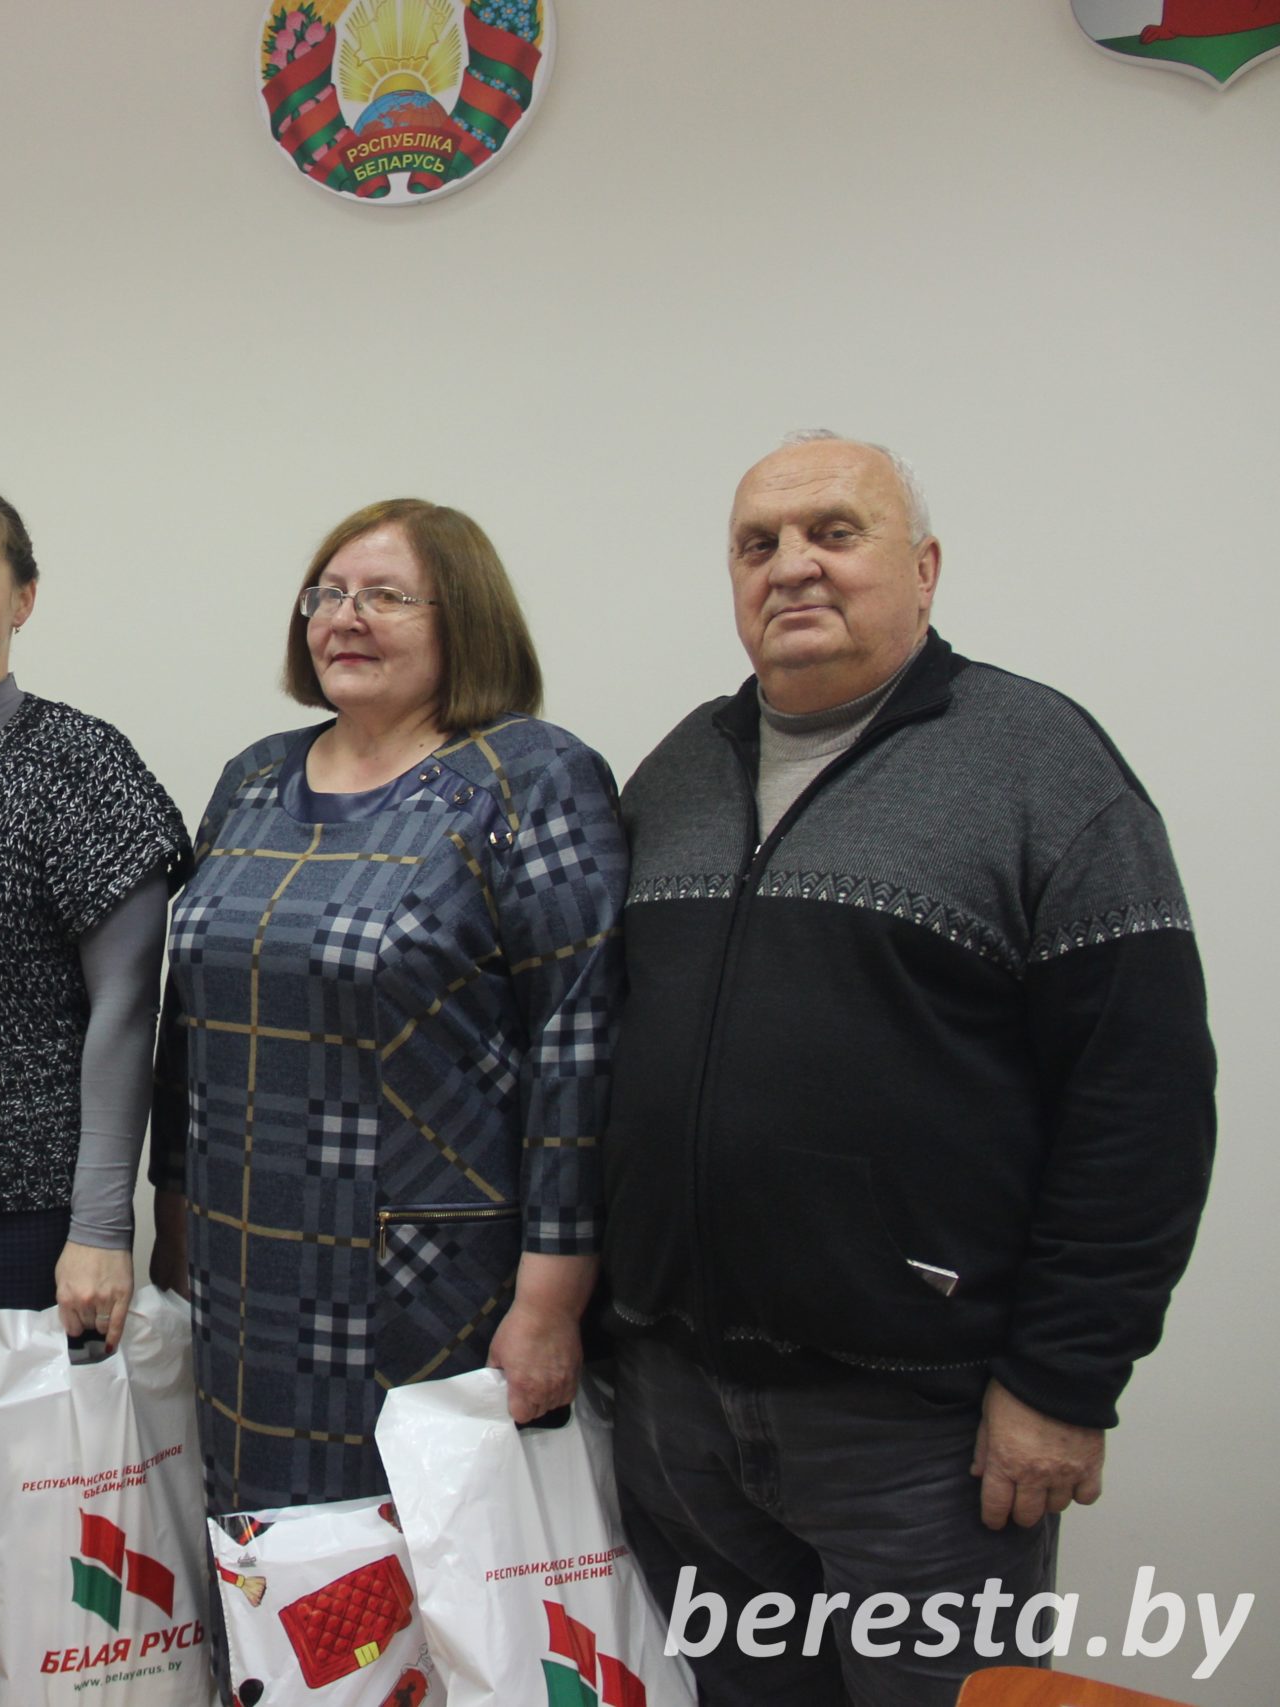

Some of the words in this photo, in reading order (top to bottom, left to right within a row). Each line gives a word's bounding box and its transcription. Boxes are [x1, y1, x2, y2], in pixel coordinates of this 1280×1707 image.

[346, 133, 452, 162] РЭСПУБЛІКА
[353, 153, 444, 181] БЕЛАРУСЬ
[40, 1639, 131, 1674] БЕЛАЯ
[139, 1619, 206, 1657] РУСЬ
